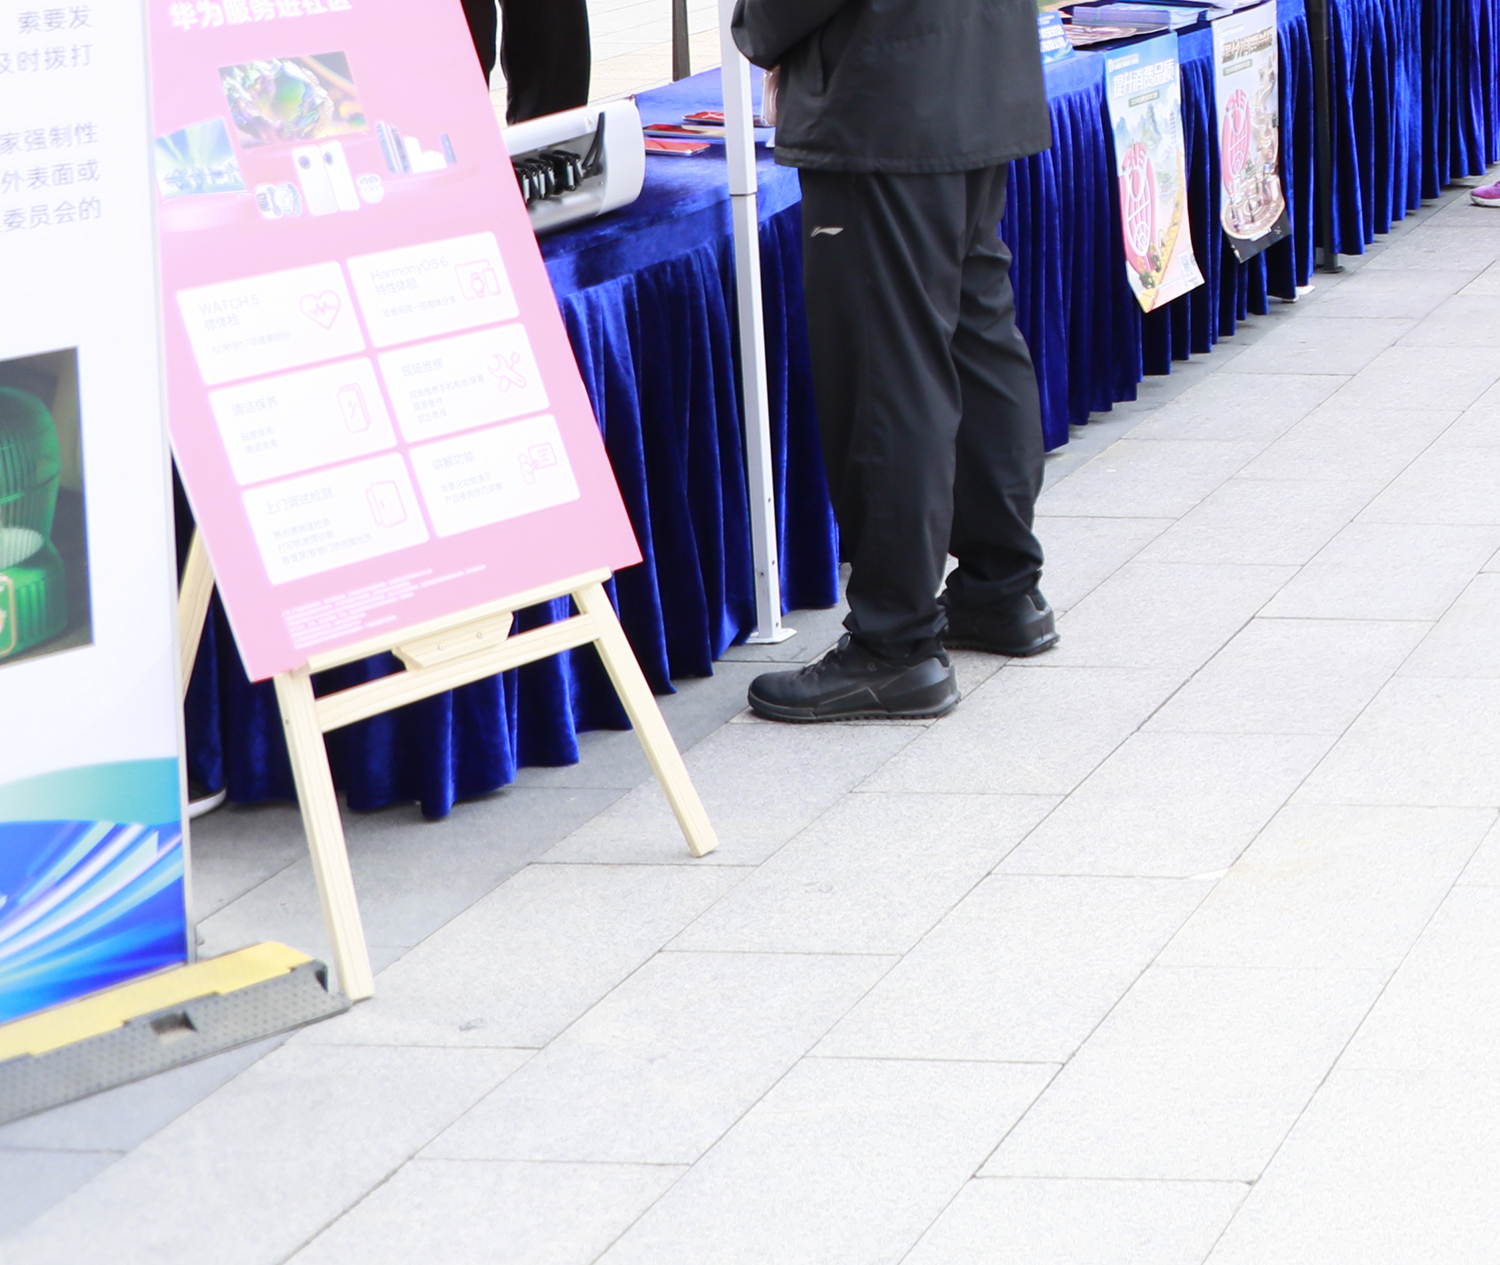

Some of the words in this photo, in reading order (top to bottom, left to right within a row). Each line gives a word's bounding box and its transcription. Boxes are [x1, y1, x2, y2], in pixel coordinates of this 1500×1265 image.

[17, 5, 93, 35] 索要发
[1, 158, 101, 195] 外表面或
